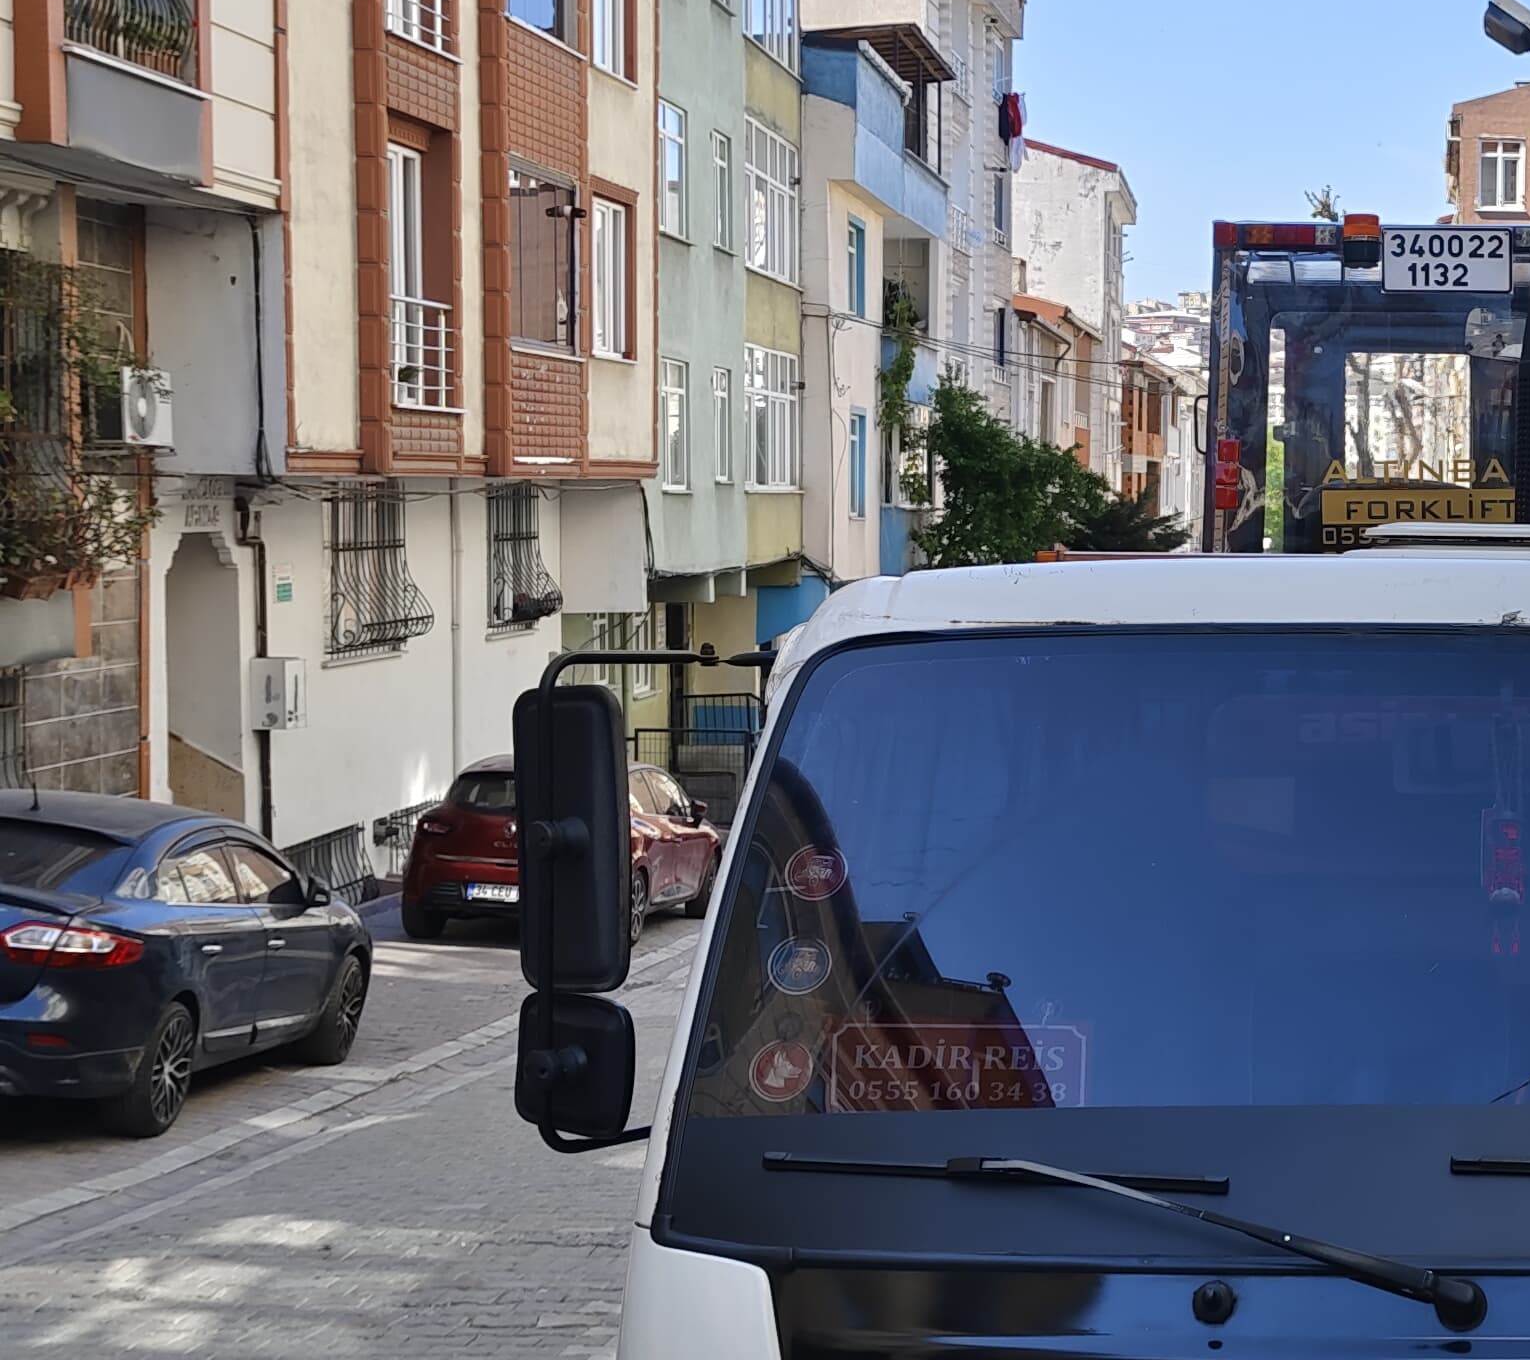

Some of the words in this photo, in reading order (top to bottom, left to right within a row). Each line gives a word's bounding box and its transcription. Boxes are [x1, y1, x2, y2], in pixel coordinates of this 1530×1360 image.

[1390, 234, 1504, 258] 340022
[1407, 262, 1469, 287] 1132
[1346, 494, 1515, 521] FORKLİFT
[1322, 527, 1390, 545] 055
[475, 885, 487, 895] 34
[855, 1039, 973, 1070] KADİR
[984, 1040, 1065, 1071] REİS
[851, 1080, 919, 1101] 0555
[929, 1081, 979, 1102] 160
[988, 1082, 1024, 1102] 34
[1032, 1082, 1066, 1102] 38
